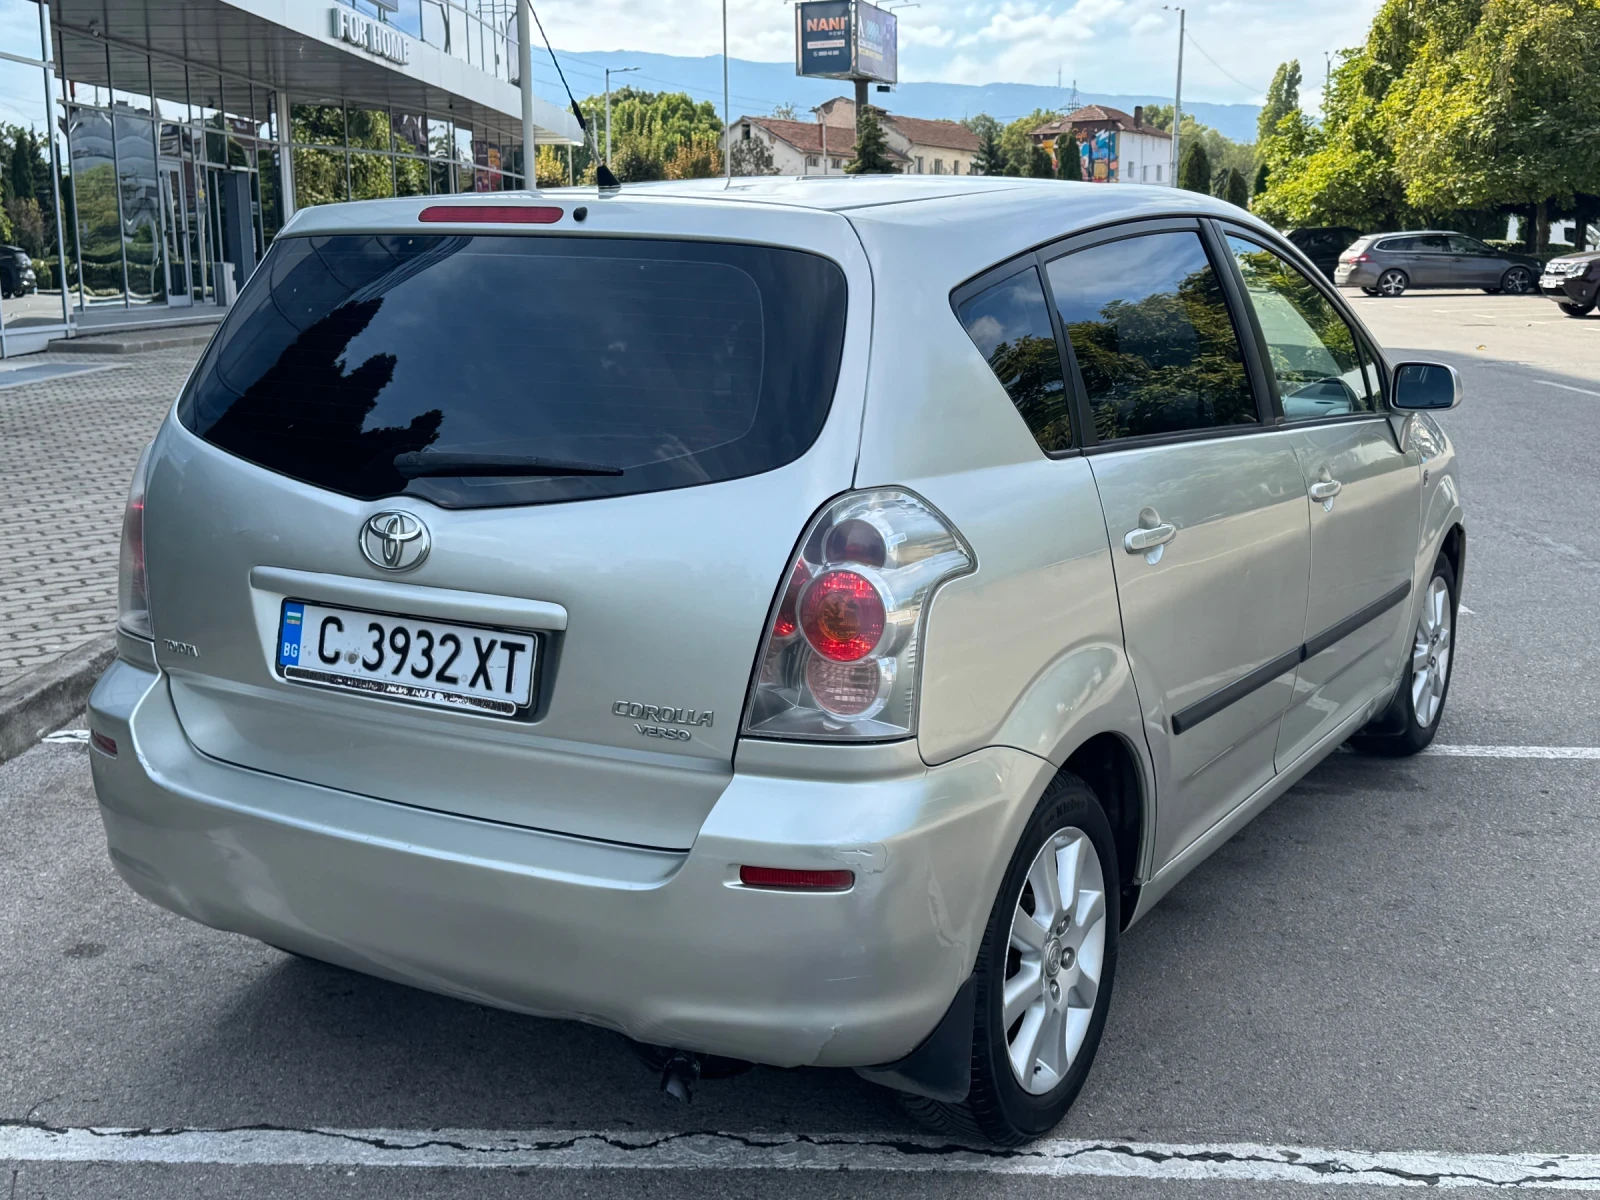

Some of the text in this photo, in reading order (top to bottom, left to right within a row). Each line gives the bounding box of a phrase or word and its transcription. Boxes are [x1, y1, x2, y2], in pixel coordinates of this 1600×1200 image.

[807, 17, 845, 32] NANI
[336, 9, 410, 65] FOR HOME
[283, 642, 298, 658] BG
[318, 616, 344, 665] C
[362, 622, 459, 685] 3932
[468, 636, 526, 694] XT
[612, 700, 714, 727] COROLLA
[634, 723, 691, 741] VERSO
